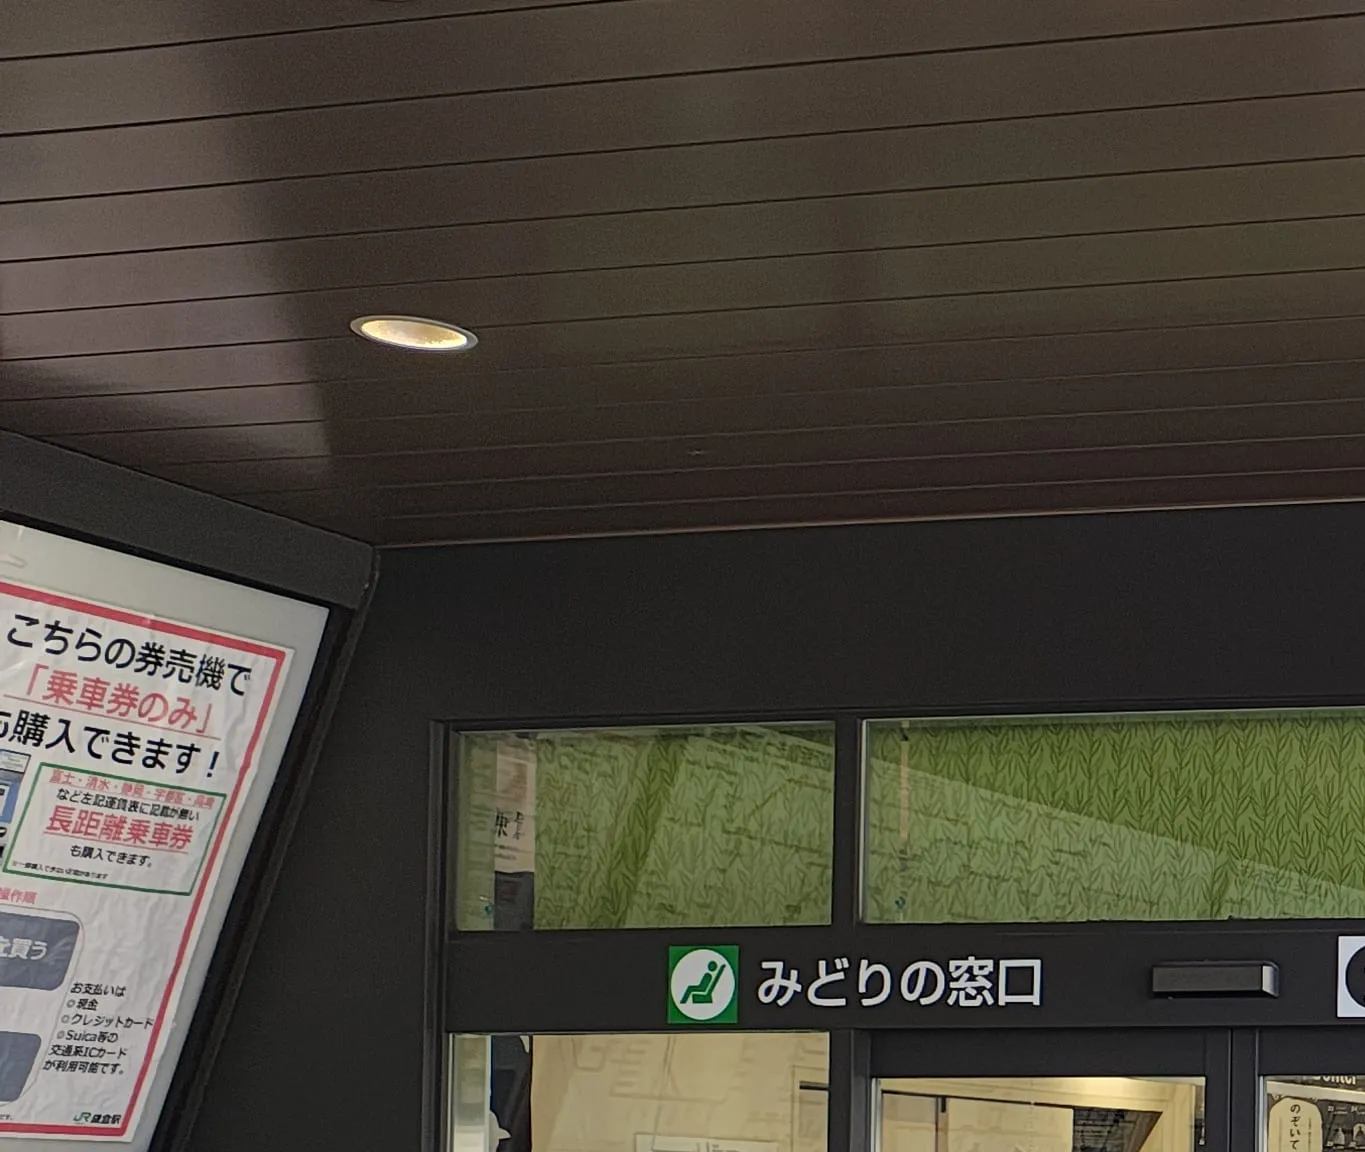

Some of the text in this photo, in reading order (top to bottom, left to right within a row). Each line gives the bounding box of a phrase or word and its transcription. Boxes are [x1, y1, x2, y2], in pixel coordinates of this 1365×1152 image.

[7, 614, 252, 696] こちらの券売機で
[46, 805, 193, 849] 長距離乗車券
[70, 982, 126, 997] お支払いは
[758, 958, 1042, 1008] みどりの窓口
[71, 1013, 153, 1029] クレジットカード
